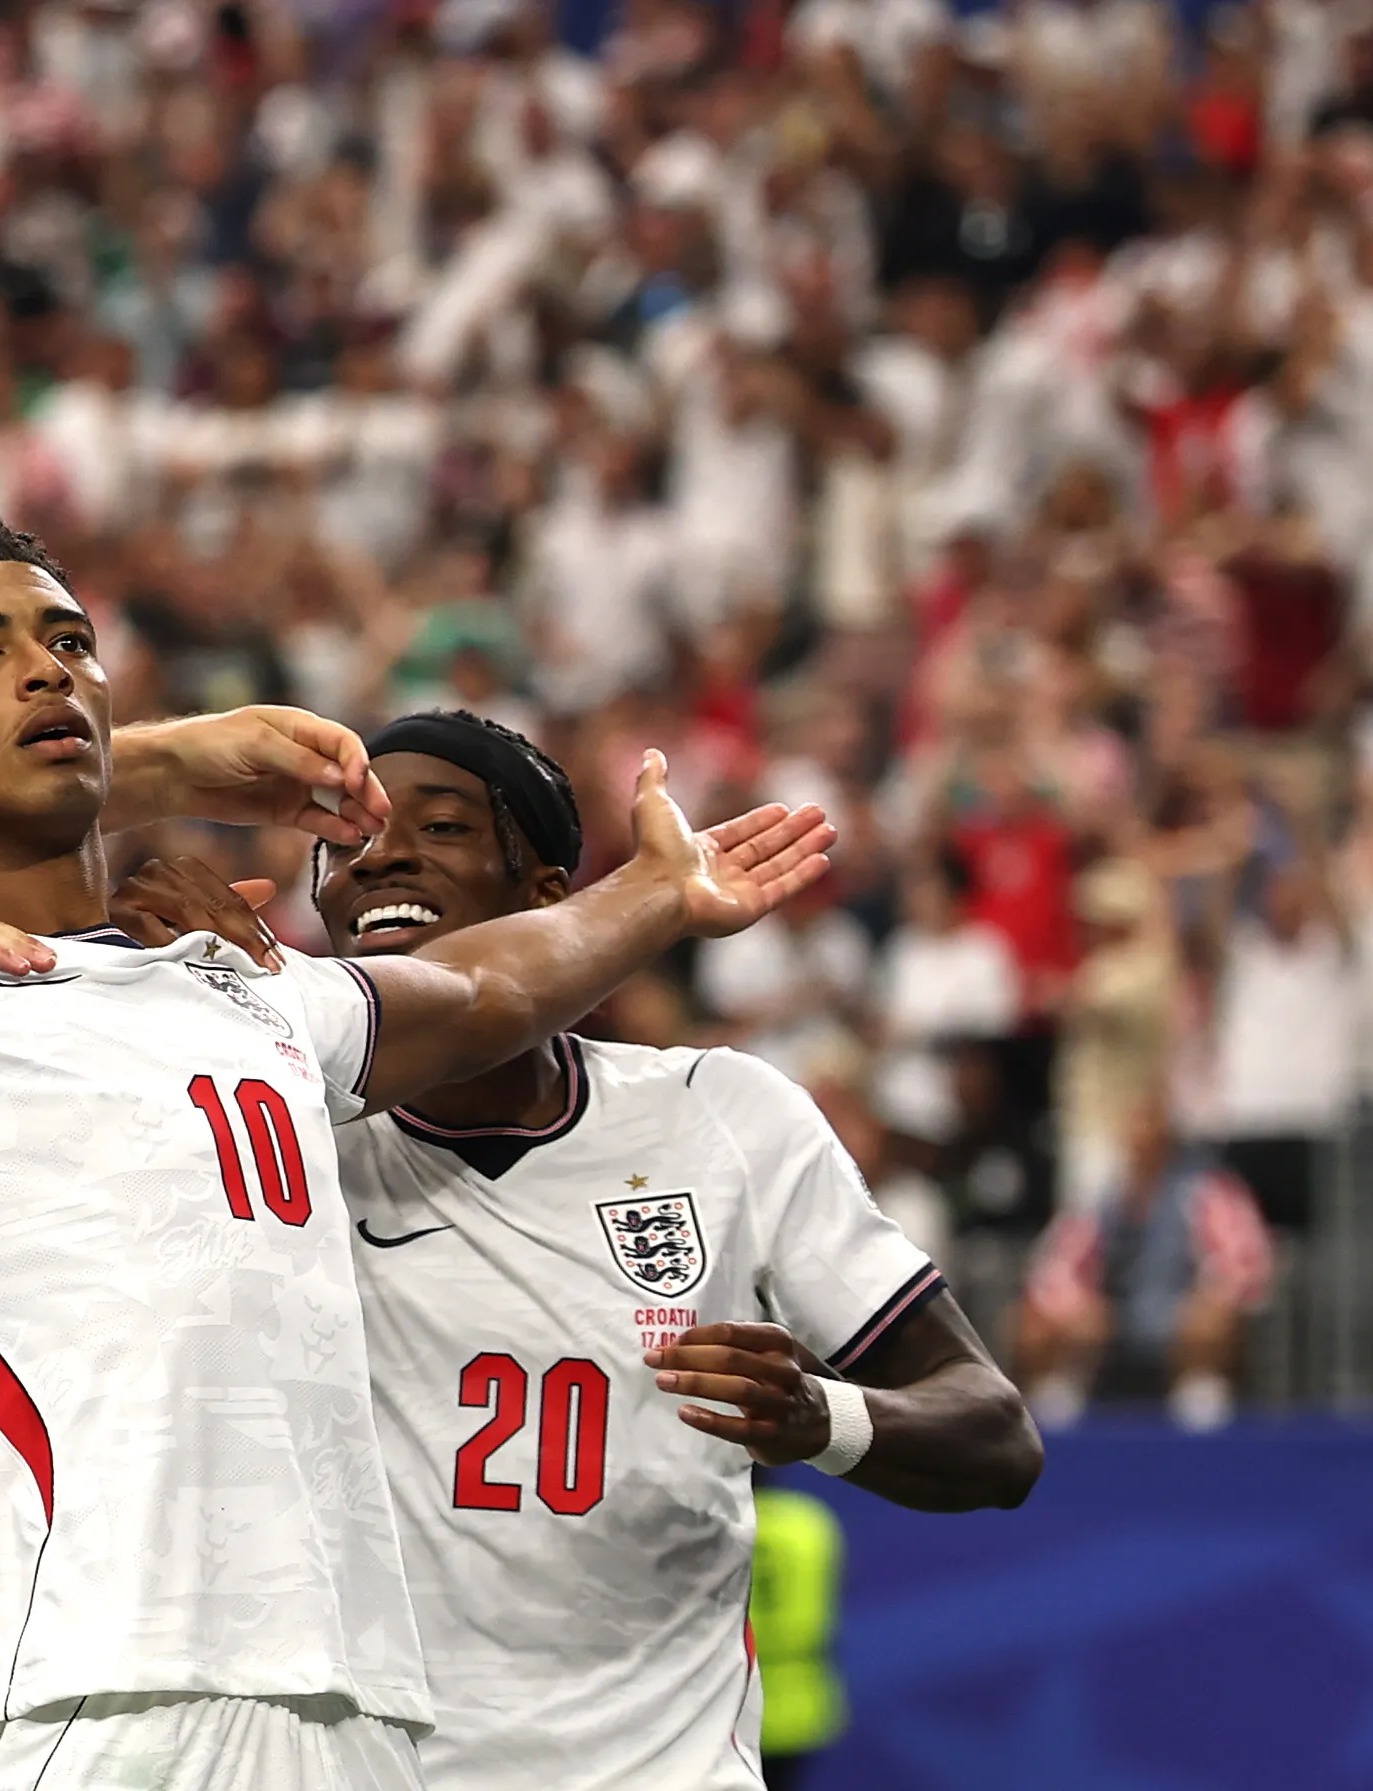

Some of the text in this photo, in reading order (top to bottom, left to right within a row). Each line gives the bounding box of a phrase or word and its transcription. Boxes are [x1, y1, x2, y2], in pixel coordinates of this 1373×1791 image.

[187, 1074, 313, 1228] 10
[635, 1308, 698, 1328] CROATIA
[453, 1352, 611, 1517] 20
